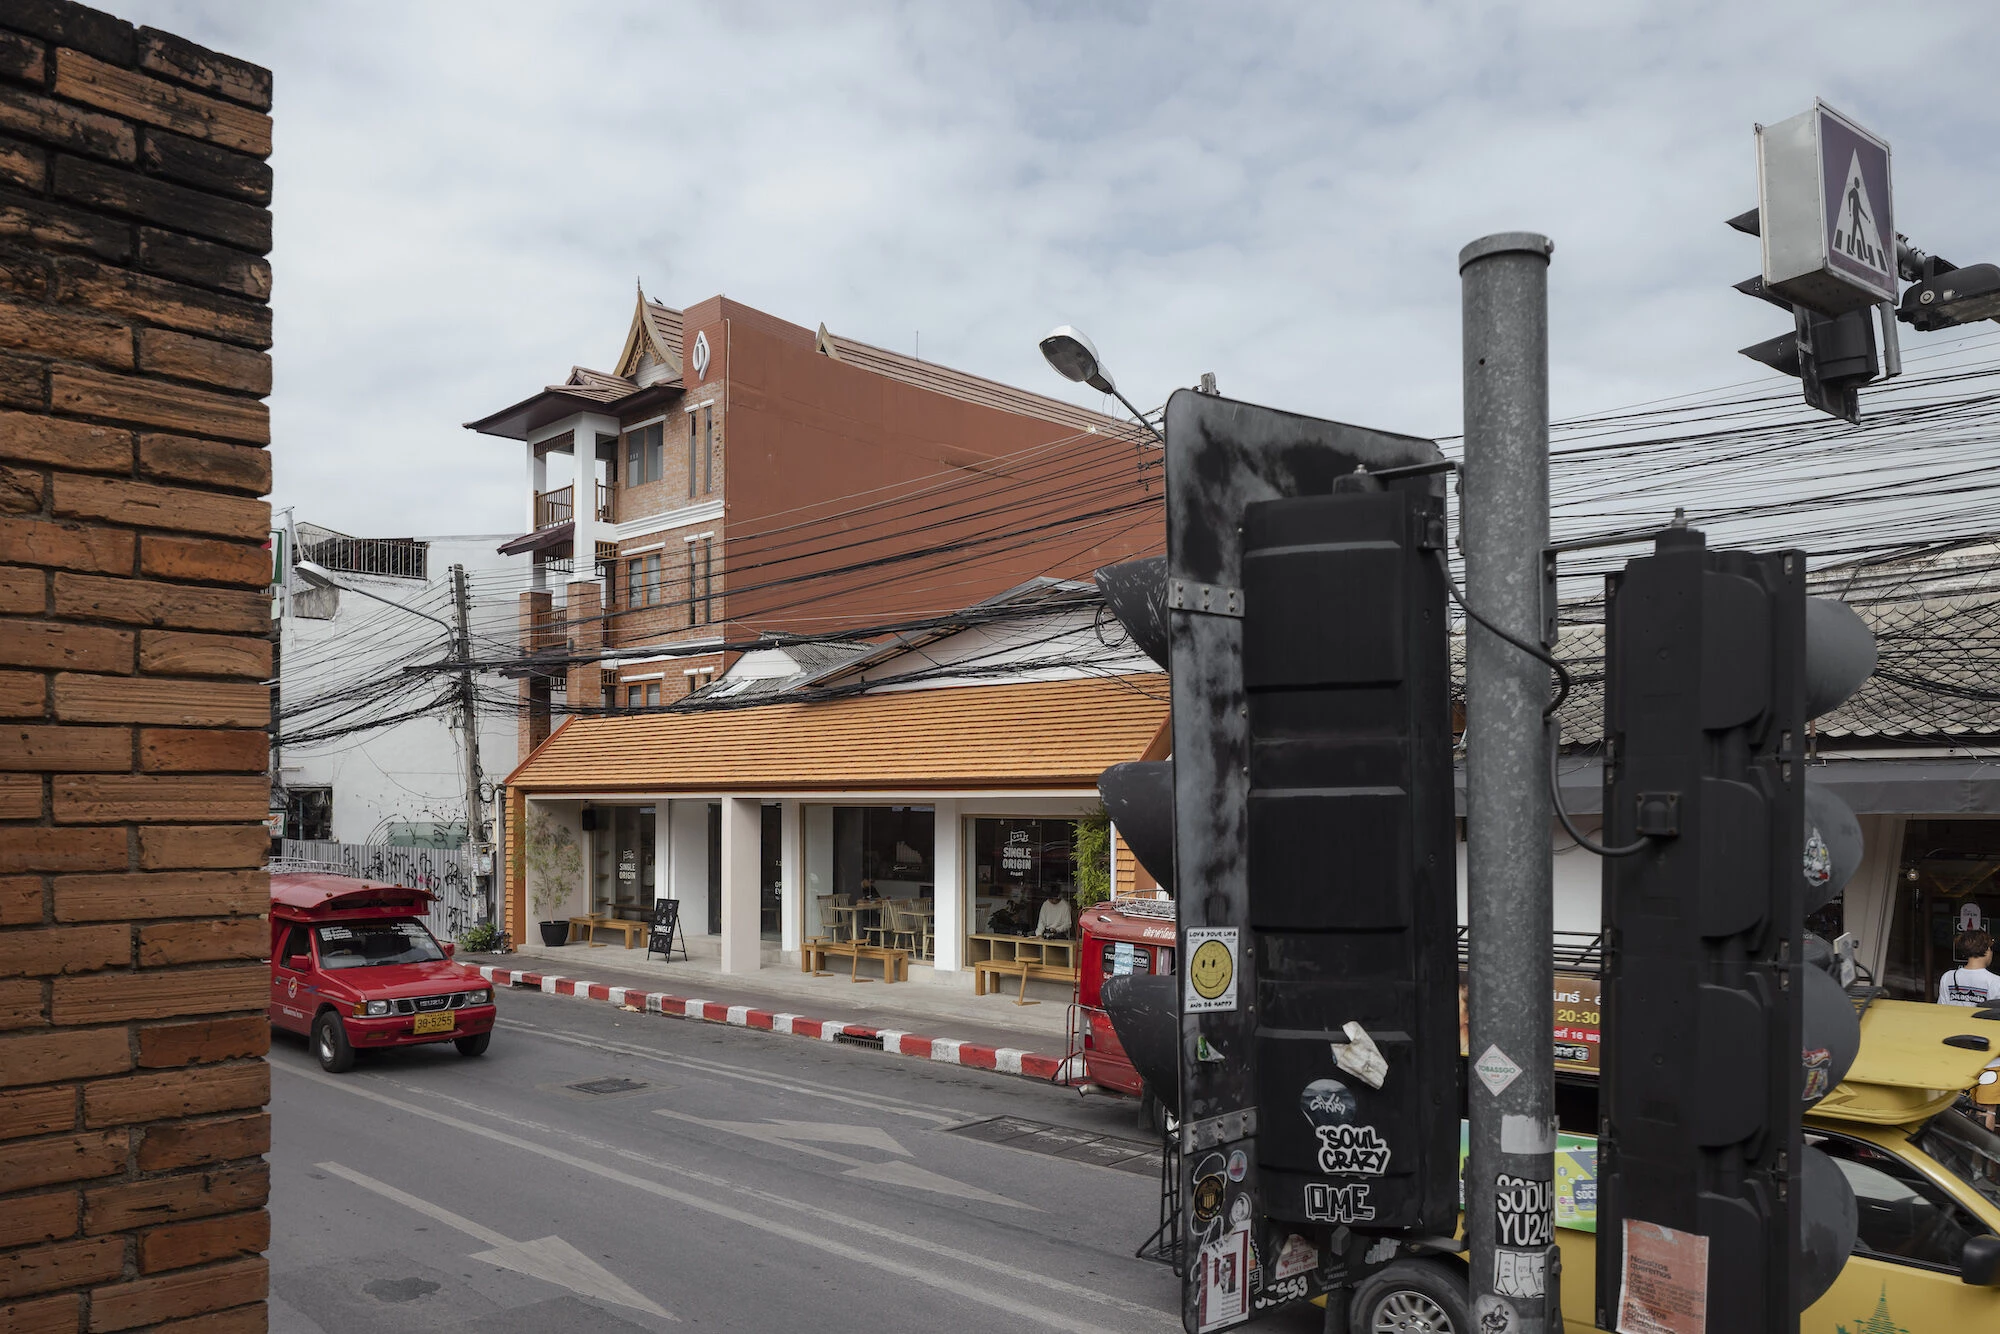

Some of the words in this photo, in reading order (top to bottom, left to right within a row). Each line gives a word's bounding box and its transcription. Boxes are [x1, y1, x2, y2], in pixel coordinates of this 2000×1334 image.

[1003, 847, 1031, 858] SINGLE
[619, 863, 636, 871] SINGLE
[1002, 858, 1031, 869] ORIGIN
[619, 871, 636, 880] ORIGIN
[654, 925, 672, 934] SINGLE
[1950, 993, 1985, 1003] patagonia
[1557, 1009, 1600, 1025] 20:30
[1571, 1031, 1583, 1040] 16
[1322, 1149, 1388, 1172] CRAZY
[1630, 1255, 1669, 1272] Nosotros
[1630, 1263, 1672, 1280] queremos
[1627, 1302, 1667, 1320] Nosotros
